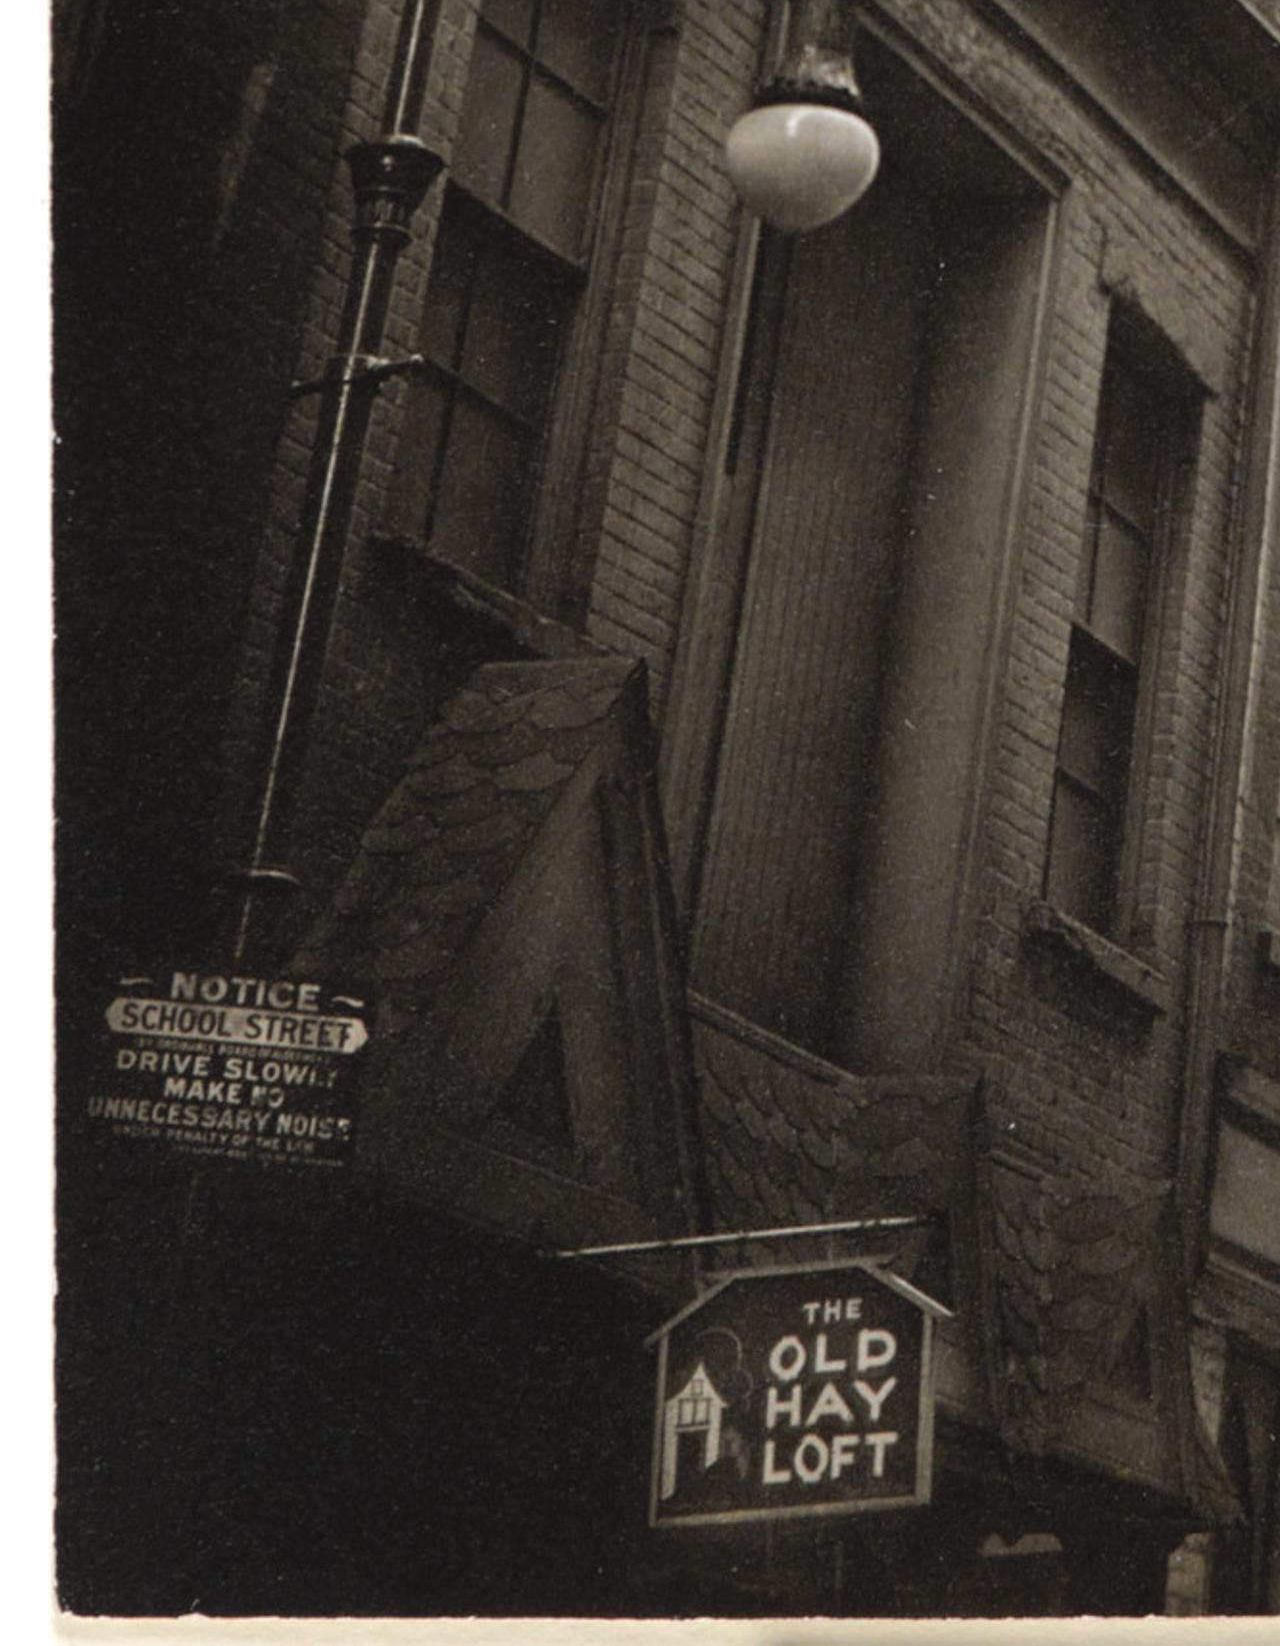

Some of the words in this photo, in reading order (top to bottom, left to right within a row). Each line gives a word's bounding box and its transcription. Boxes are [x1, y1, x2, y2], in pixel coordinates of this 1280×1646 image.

[170, 971, 322, 1012] NOTICE
[121, 1002, 232, 1037] SCHOOL
[243, 1014, 354, 1049] STREET
[116, 1048, 211, 1077] DRIVE
[163, 1076, 243, 1105] MAKE
[250, 1084, 286, 1109] NO
[87, 1095, 272, 1133] UNNECESSARY
[803, 1297, 864, 1326] THE
[768, 1328, 898, 1382] OLD
[766, 1376, 898, 1429] HAY
[762, 1431, 900, 1486] LOFT
